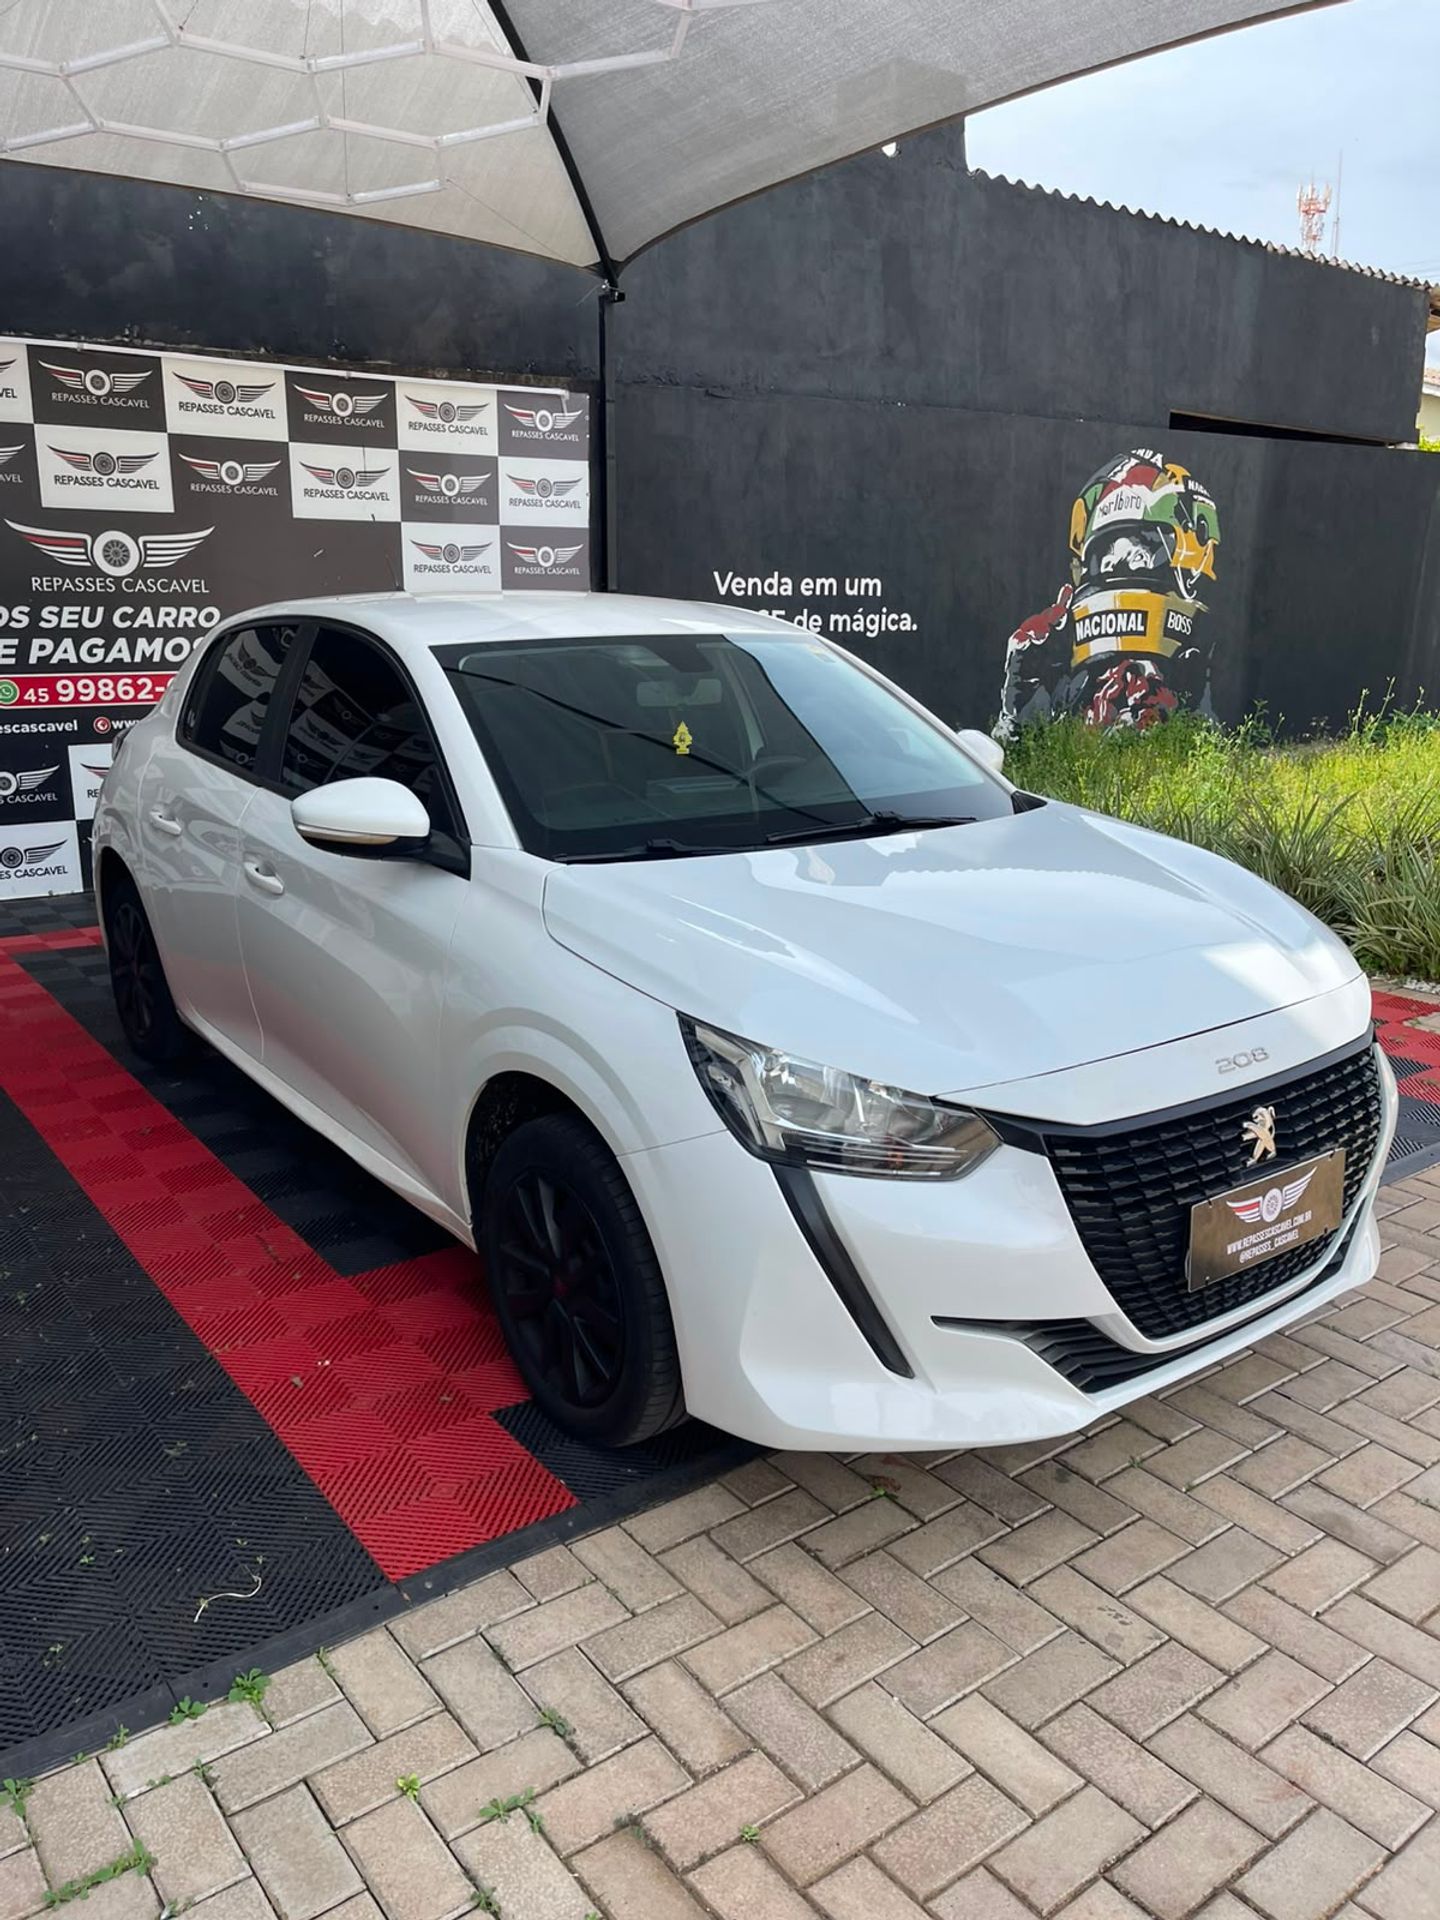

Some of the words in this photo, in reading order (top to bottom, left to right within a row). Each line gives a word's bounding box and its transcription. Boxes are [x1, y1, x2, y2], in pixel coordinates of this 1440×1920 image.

[51, 391, 98, 405] REPASSES
[100, 397, 150, 409] CASCAVEL
[178, 401, 225, 415] REPASSES
[227, 405, 276, 419] CASCAVEL
[303, 413, 342, 426] REPASSES
[344, 415, 385, 429] CASCAVEL
[408, 421, 447, 434] REPASSES
[449, 424, 489, 436] CASCAVEL
[511, 429, 544, 440] REPASSES
[546, 431, 580, 442] CASCAVEL
[54, 474, 104, 487] REPASSES
[106, 477, 160, 490] CASCAVEL
[190, 482, 232, 495] REPASSES
[234, 485, 279, 497] CASCAVEL
[303, 488, 345, 500] REPASSES
[346, 489, 390, 502] CASCAVEL
[415, 494, 450, 505] REPASSES
[451, 495, 488, 507] CASCAVEL
[509, 497, 543, 509] REPASSES
[544, 498, 581, 510] CASCAVEL
[414, 563, 450, 574] REPASSES
[452, 563, 492, 575] CASCAVEL
[514, 566, 545, 576] REPASSES
[547, 566, 580, 576] CASCAVEL
[31, 577, 116, 592] REPASSES
[121, 578, 210, 593] CASCAVEL
[713, 571, 793, 597] Venda
[799, 576, 838, 597] em
[844, 576, 882, 597] um
[38, 605, 105, 629] SEU
[112, 606, 221, 629] CARRO
[794, 608, 822, 633] de
[829, 606, 918, 638] mágica.
[1167, 611, 1192, 636] BOSS
[1076, 612, 1145, 641] NACIONAL
[23, 688, 50, 703] 45
[55, 677, 175, 703] 99862-
[6, 792, 58, 804] CASCAVEL
[14, 864, 69, 879] CASCAVEL
[1215, 1047, 1270, 1075] 208
